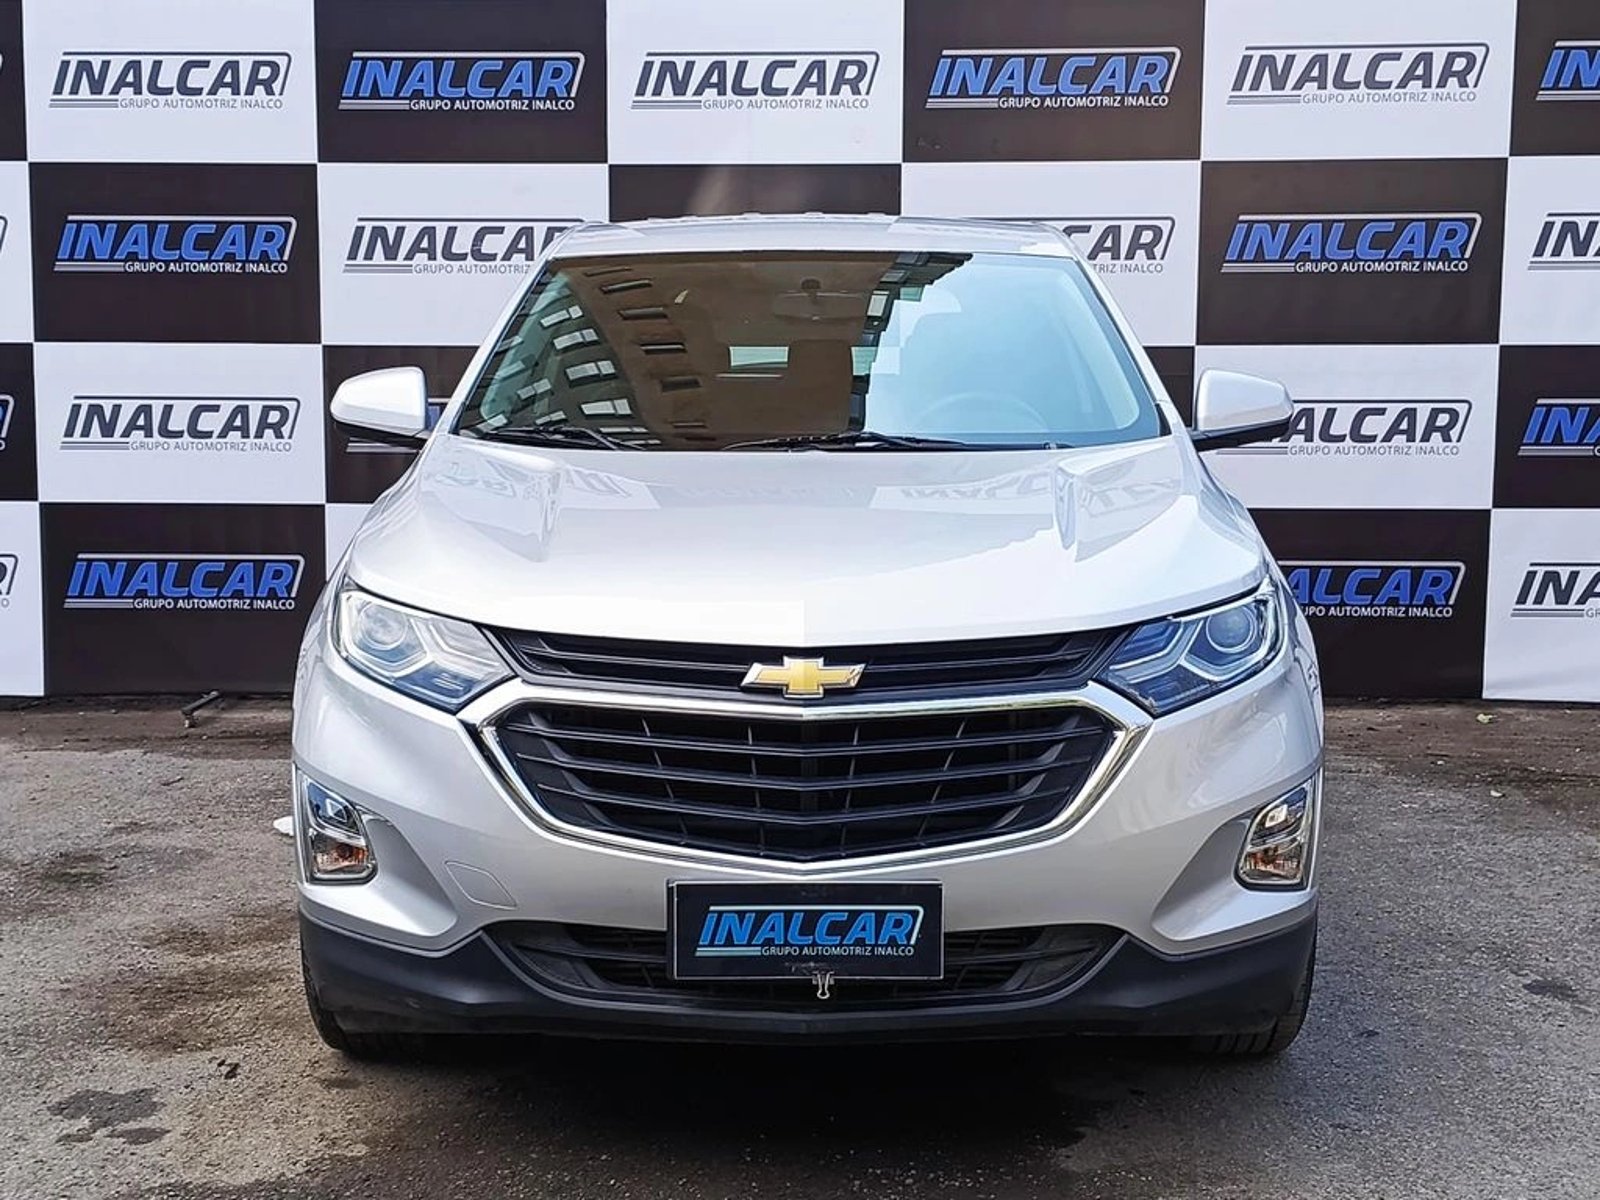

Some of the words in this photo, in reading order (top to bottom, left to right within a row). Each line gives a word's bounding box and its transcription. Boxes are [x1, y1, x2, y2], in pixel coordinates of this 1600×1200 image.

[929, 54, 1169, 96] INALCAR
[1231, 52, 1477, 91] INALCAR
[52, 60, 280, 96] INALCAR
[340, 60, 574, 97] INALCAR
[635, 59, 868, 97] INALCAR
[120, 98, 159, 109] GRUPO
[163, 98, 237, 109] AUTOMOTRIZ
[241, 98, 283, 109] INALCO
[703, 98, 744, 109] GRUPO
[747, 98, 822, 109] AUTOMOTRIZ
[826, 98, 869, 109] INALCO
[999, 97, 1039, 108] GRUPO
[1044, 96, 1121, 108] AUTOMOTRIZ
[1124, 95, 1168, 107] INALCO
[1302, 93, 1344, 104] GRUPO
[1348, 92, 1427, 103] AUTOMOTRIZ
[1431, 91, 1477, 102] INALCO
[411, 100, 451, 110] GRUPO
[454, 100, 529, 110] AUTOMOTRIZ
[532, 100, 575, 110] INALCO
[57, 223, 286, 260] INALCAR
[1225, 220, 1471, 261] INALCAR
[126, 262, 165, 273] GRUPO
[168, 262, 242, 273] AUTOMOTRIZ
[245, 262, 288, 273] INALCO
[414, 263, 453, 274] GRUPO
[1120, 263, 1163, 273] INALCO
[1295, 261, 1338, 272] GRUPO
[1341, 261, 1420, 272] AUTOMOTRIZ
[1423, 261, 1468, 272] INALCO
[64, 403, 290, 439] INALCAR
[131, 441, 170, 452] GRUPO
[174, 441, 247, 452] AUTOMOTRIZ
[250, 441, 292, 452] INALCO
[1289, 445, 1330, 456] GRUPO
[1334, 445, 1412, 456] AUTOMOTRIZ
[1415, 445, 1459, 456] INALCO
[66, 560, 295, 598] INALCAR
[134, 599, 174, 609] GRUPO
[176, 599, 250, 609] AUTOMOTRIZ
[253, 599, 295, 609] INALCO
[1328, 606, 1405, 617] AUTOMOTRIZ
[1408, 606, 1453, 618] INALCO
[698, 912, 914, 945] INALCAR
[762, 946, 799, 956] GRUPO
[802, 946, 872, 956] AUTOMOTRIZ
[875, 946, 914, 956] INALCO
